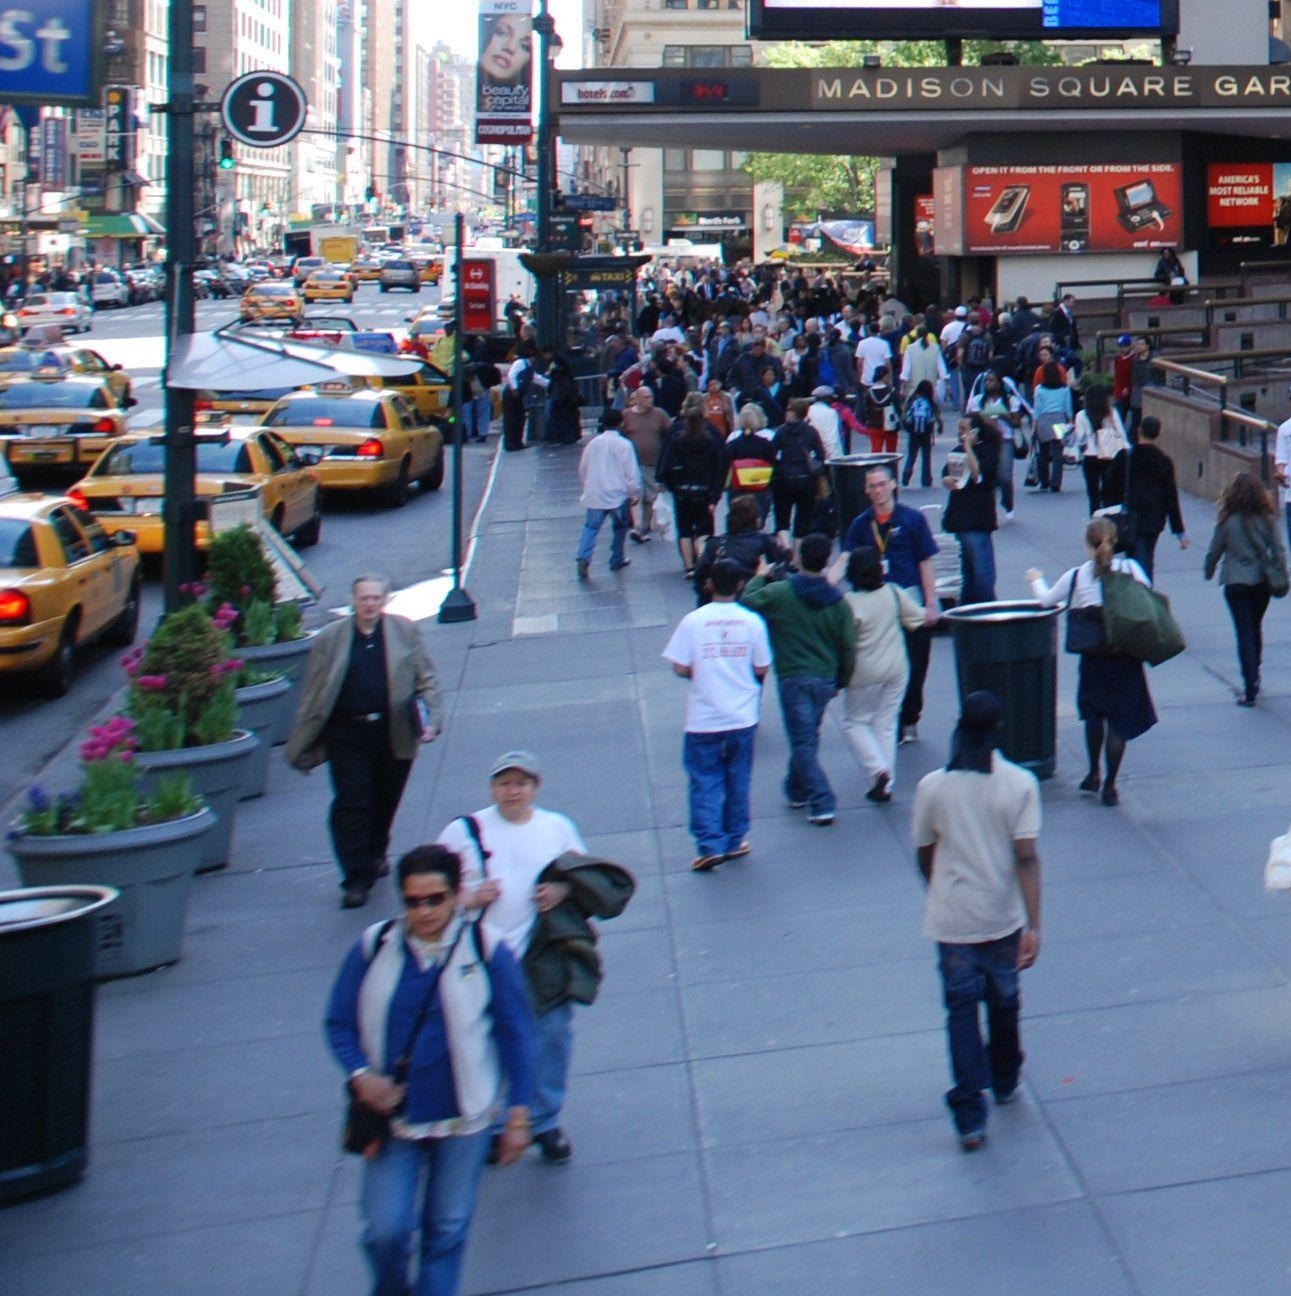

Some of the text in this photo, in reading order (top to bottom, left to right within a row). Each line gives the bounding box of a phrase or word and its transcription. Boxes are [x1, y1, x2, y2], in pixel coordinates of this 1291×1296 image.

[493, 2, 517, 11] NYC
[0, 8, 72, 75] St
[817, 77, 1003, 98] MADISON
[1029, 76, 1193, 98] SQUARE
[106, 104, 120, 161] PARK
[1218, 174, 1260, 185] AMERICA'S
[1208, 184, 1269, 195] MOST RELIABLE
[1219, 196, 1259, 207] NETWORK
